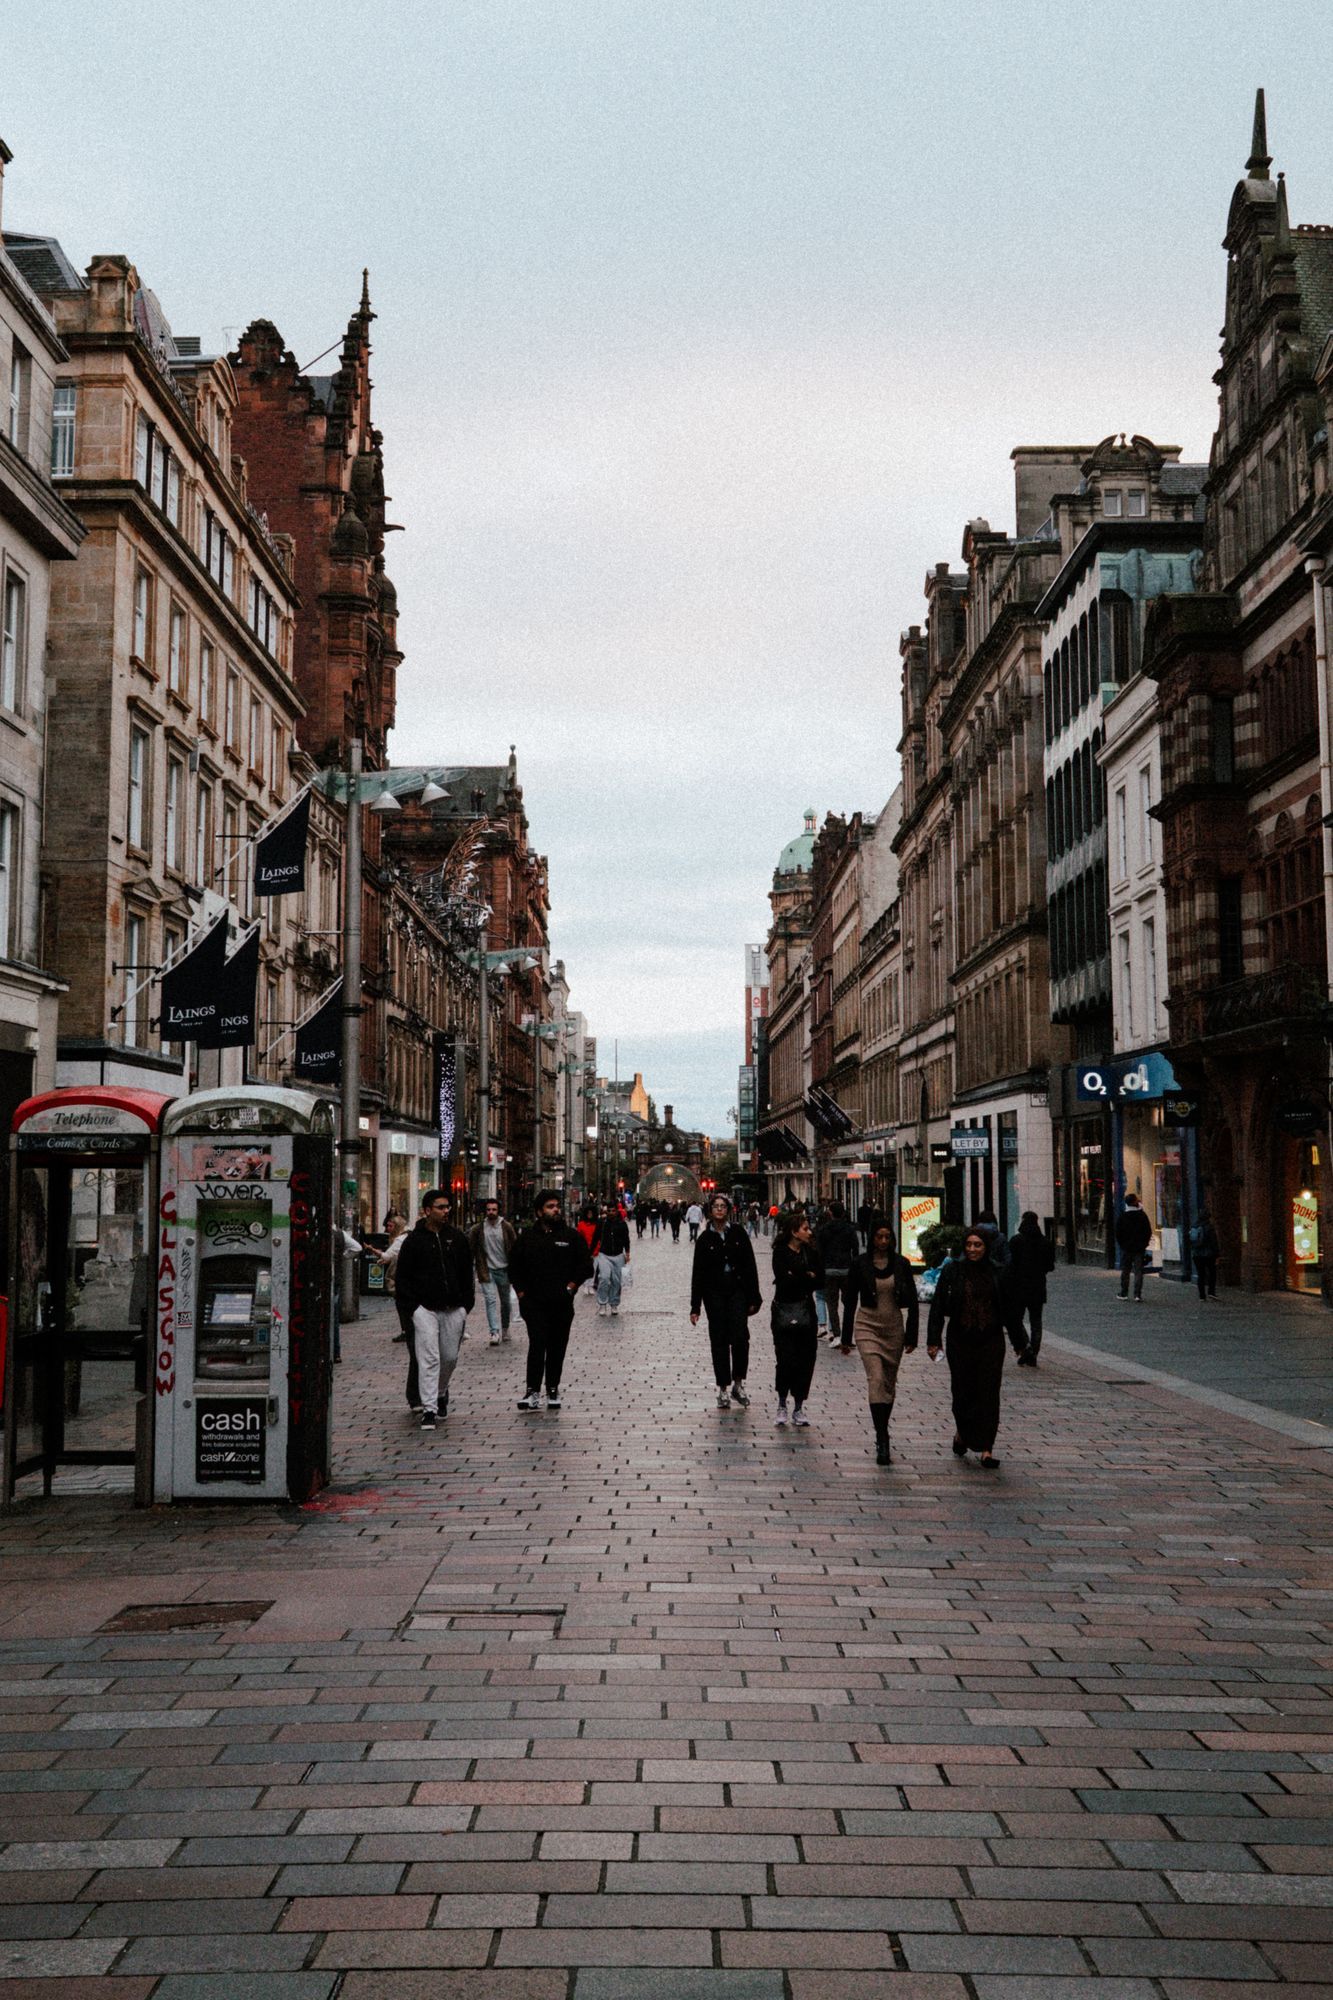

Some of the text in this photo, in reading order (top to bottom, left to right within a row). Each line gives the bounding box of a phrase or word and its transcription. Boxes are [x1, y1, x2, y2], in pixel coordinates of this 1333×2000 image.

[260, 865, 300, 881] LAINGS
[167, 1005, 216, 1023] LAINGS
[300, 1050, 336, 1065] LAINGS
[54, 1112, 116, 1127] Telephone
[47, 1137, 76, 1149] Coins
[90, 1137, 121, 1149] Cards
[954, 1139, 985, 1148] LET BY
[156, 1191, 178, 1397] GLASGOW
[201, 1407, 260, 1431] cash
[201, 1433, 260, 1441] withdrawals and
